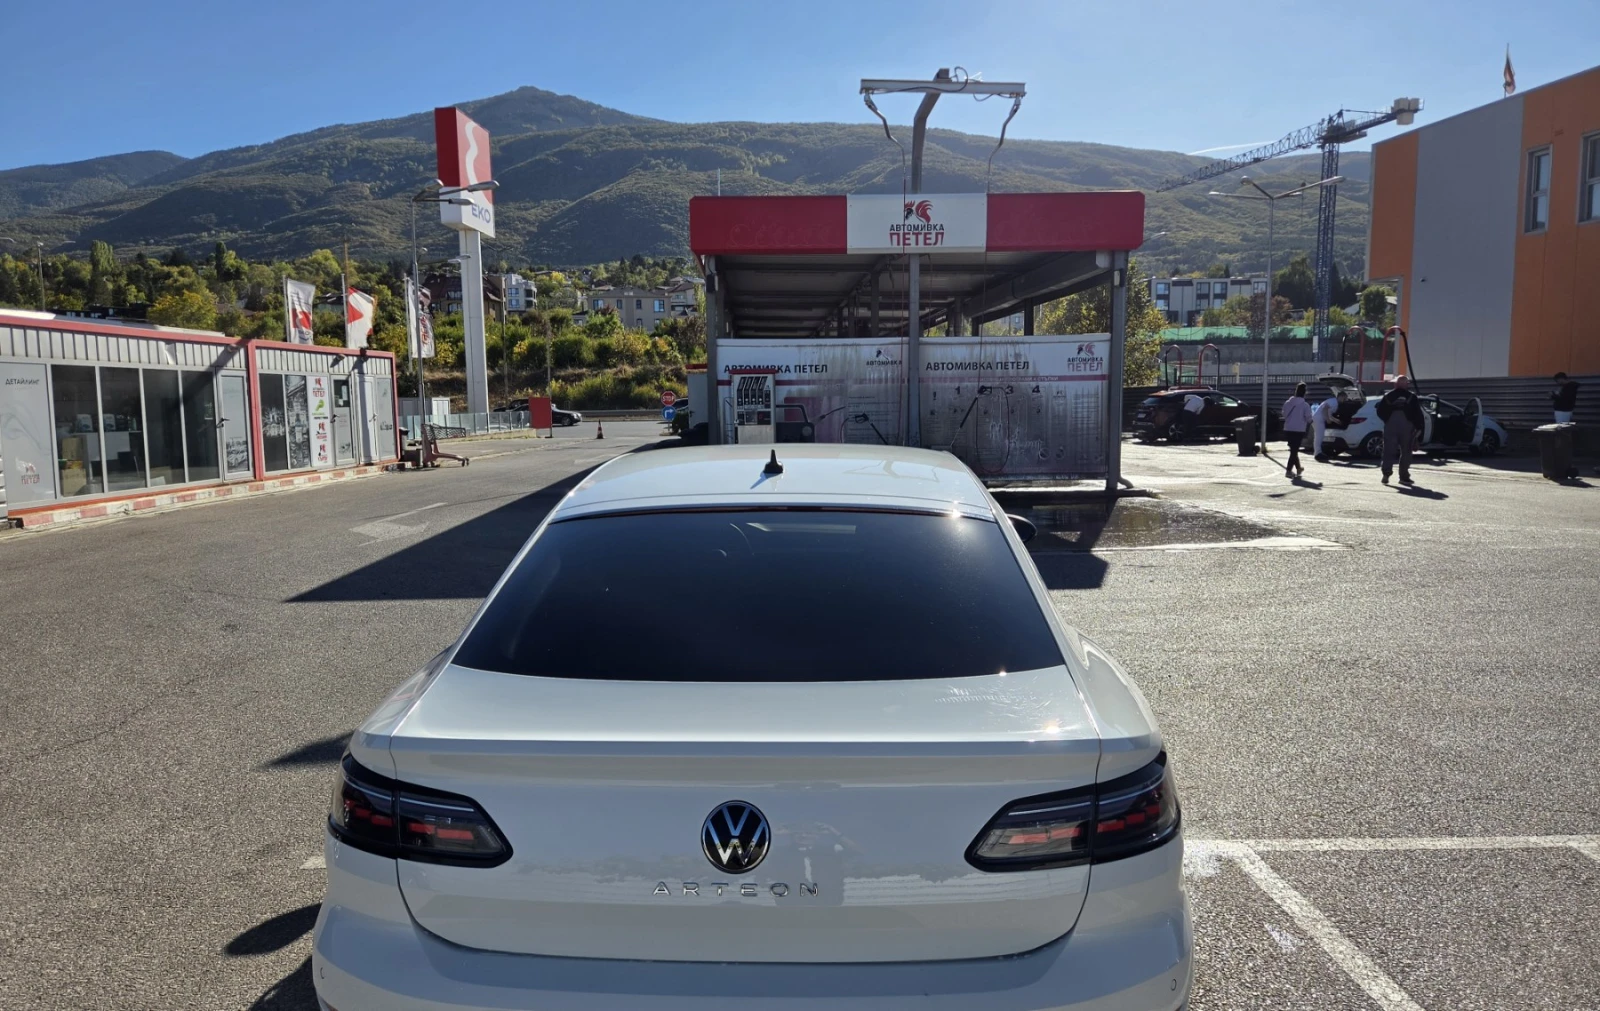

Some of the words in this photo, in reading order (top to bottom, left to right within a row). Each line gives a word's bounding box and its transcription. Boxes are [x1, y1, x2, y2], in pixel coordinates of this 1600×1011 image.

[471, 204, 490, 223] EKO
[889, 223, 944, 231] АВТОМИВКА
[889, 232, 944, 246] ПЕТЕЛ
[795, 364, 828, 373] ПЕТЕЛ
[926, 361, 992, 371] АВТОМИВКА
[995, 361, 1029, 370] ПЕТЕЛ
[1067, 363, 1103, 372] ПЕТЕЛ
[1032, 384, 1040, 394] 4
[653, 881, 819, 897] ARTEON
